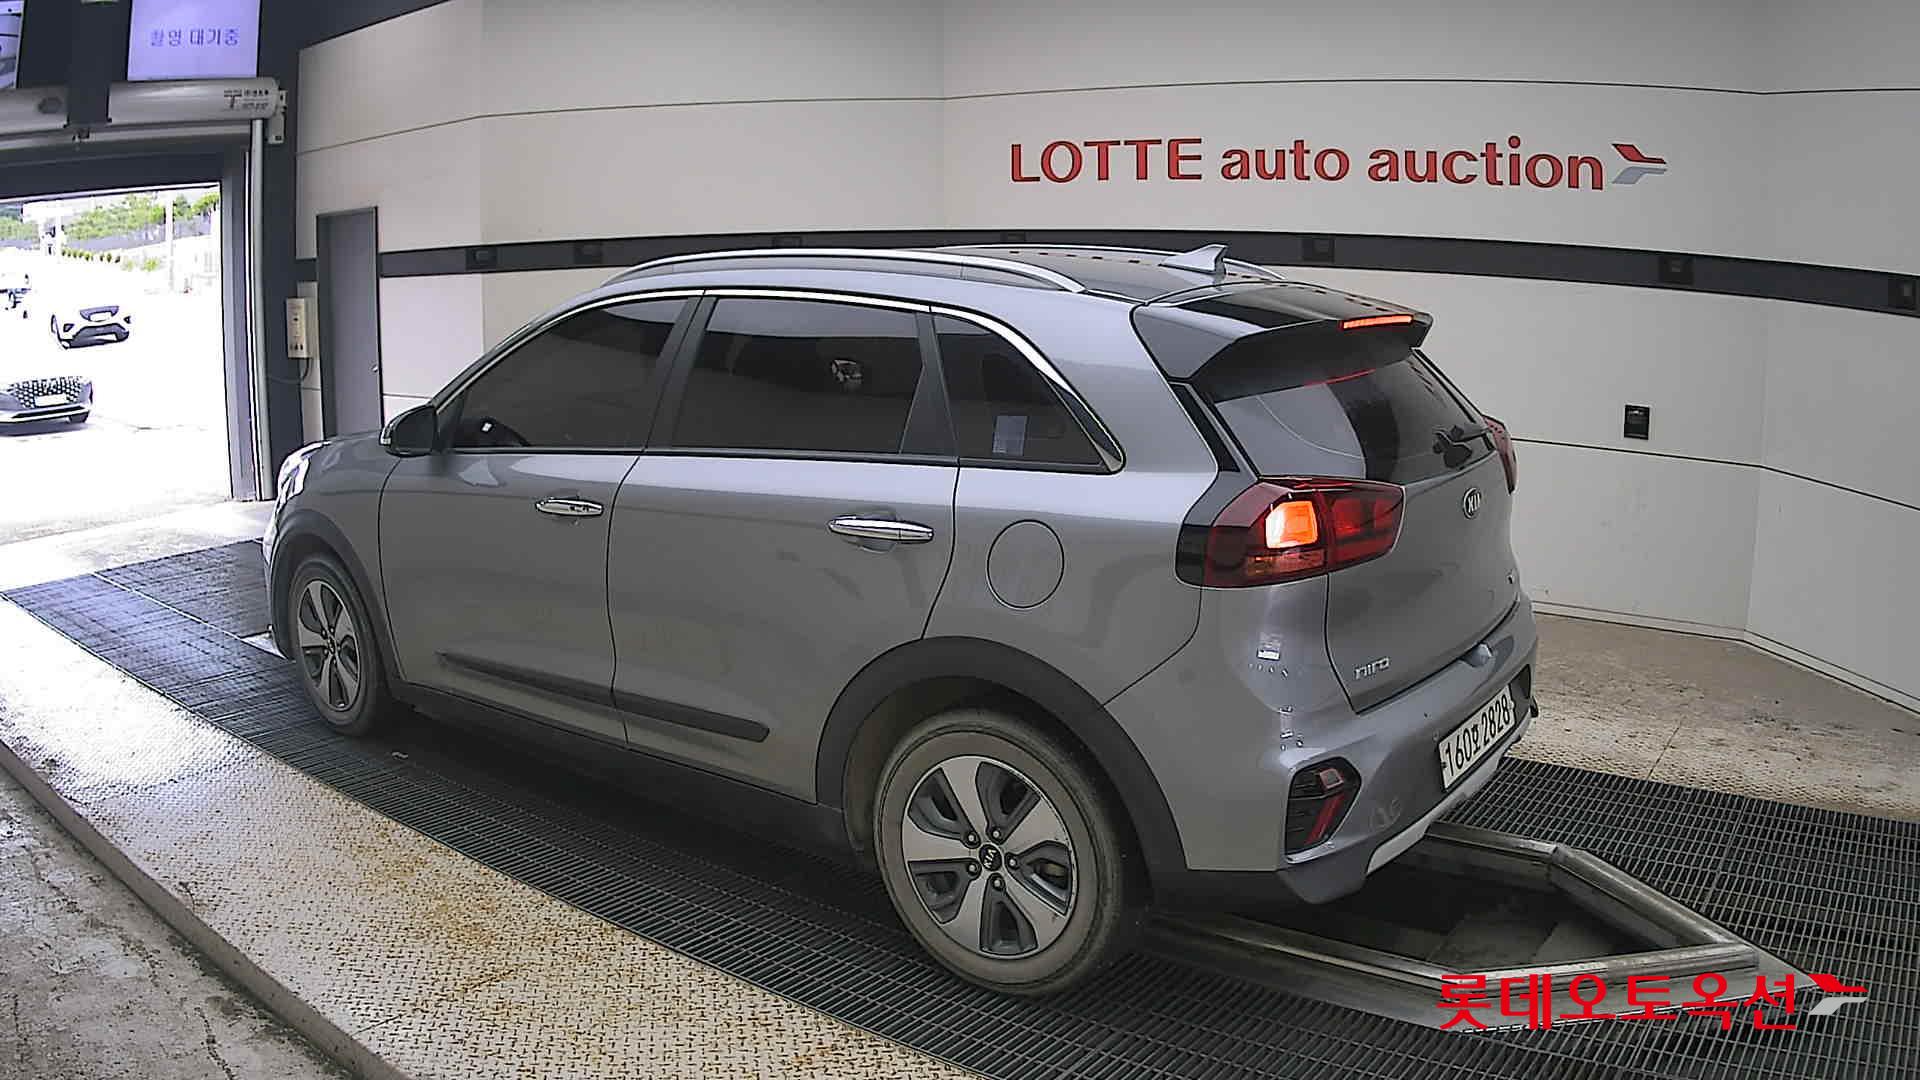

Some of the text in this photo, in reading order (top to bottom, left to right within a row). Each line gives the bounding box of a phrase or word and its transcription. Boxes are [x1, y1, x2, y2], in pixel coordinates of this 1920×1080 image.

[190, 28, 239, 47] 대기중
[1011, 135, 1604, 191] LOTTE auto auction
[1481, 694, 1511, 747] 2828
